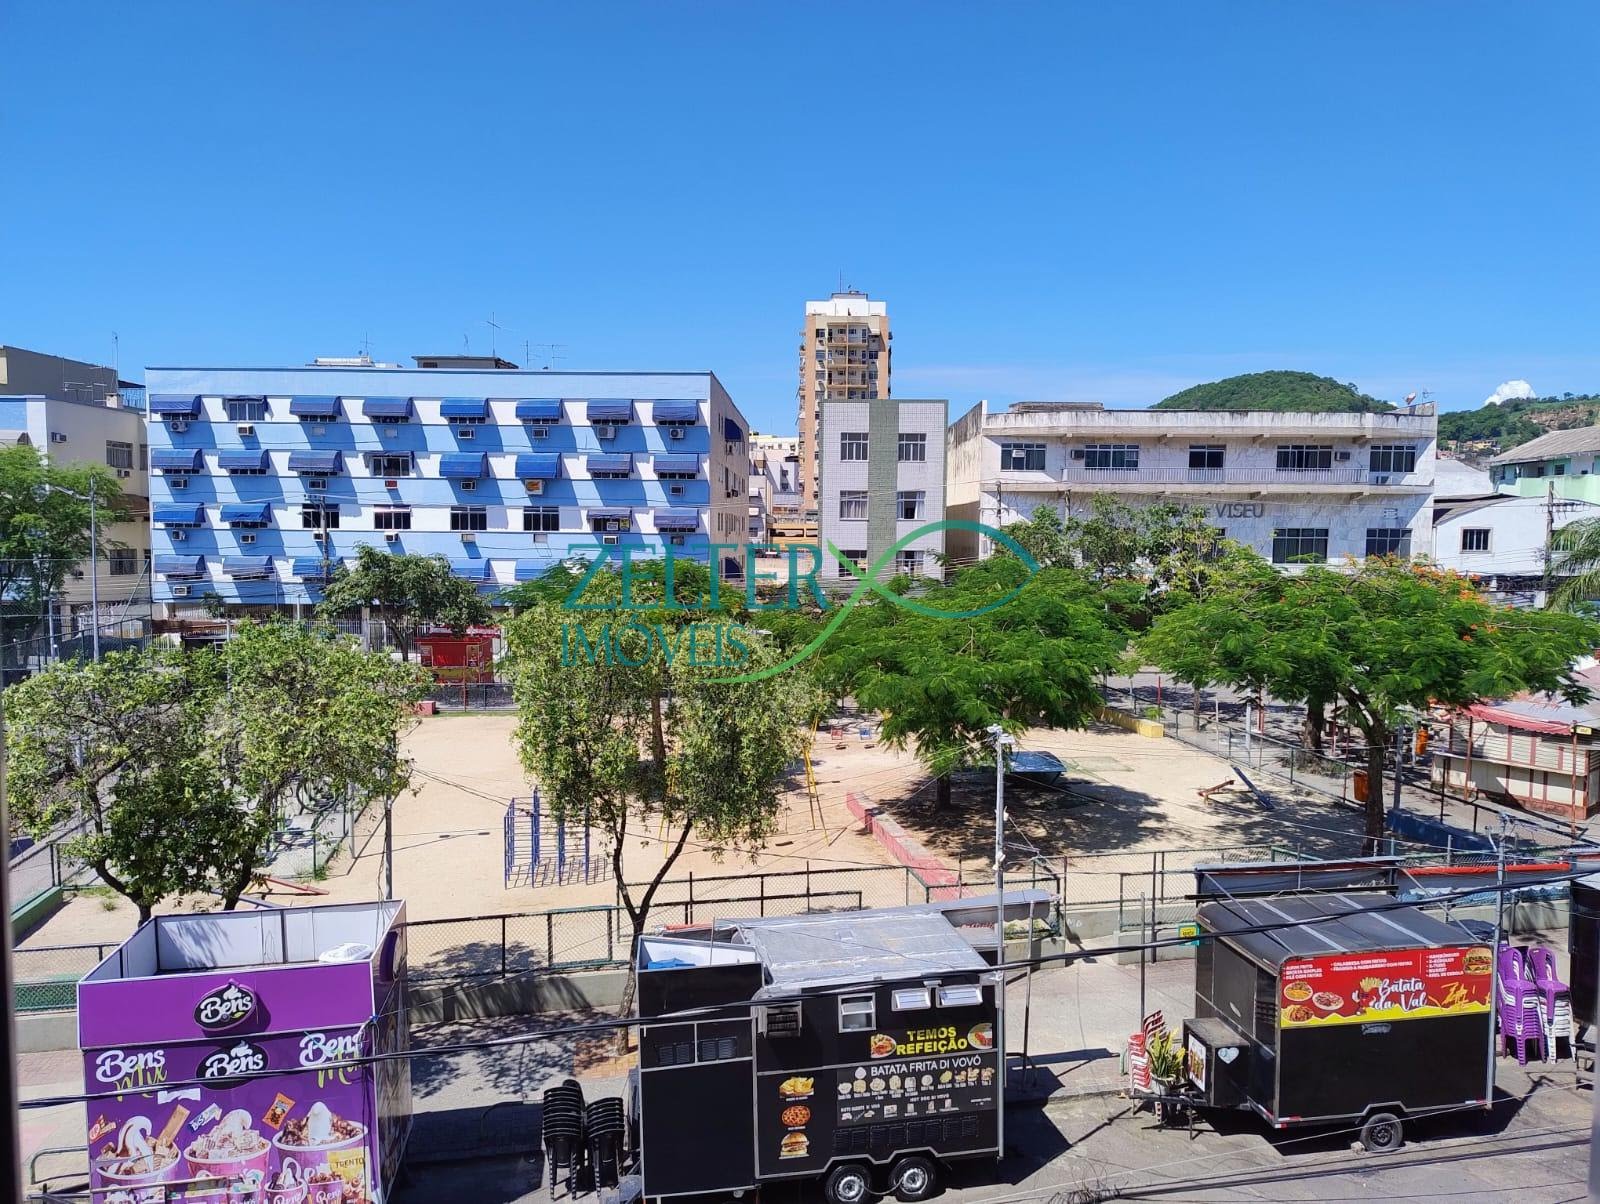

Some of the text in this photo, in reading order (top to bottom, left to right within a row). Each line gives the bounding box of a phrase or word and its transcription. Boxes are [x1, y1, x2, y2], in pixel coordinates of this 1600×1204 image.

[1215, 503, 1264, 519] VISEU
[1379, 977, 1426, 997] Batata
[200, 996, 252, 1023] Bens
[1375, 992, 1428, 1012] da Val
[907, 1026, 957, 1042] TEMOS
[896, 1037, 968, 1056] REFEIÇÃO
[96, 1049, 165, 1082] Bens
[205, 1052, 264, 1079] Bens
[871, 1063, 908, 1077] BATATA
[909, 1060, 938, 1073] FRITA
[940, 1059, 950, 1070] DI
[335, 1157, 365, 1169] TRENTO
